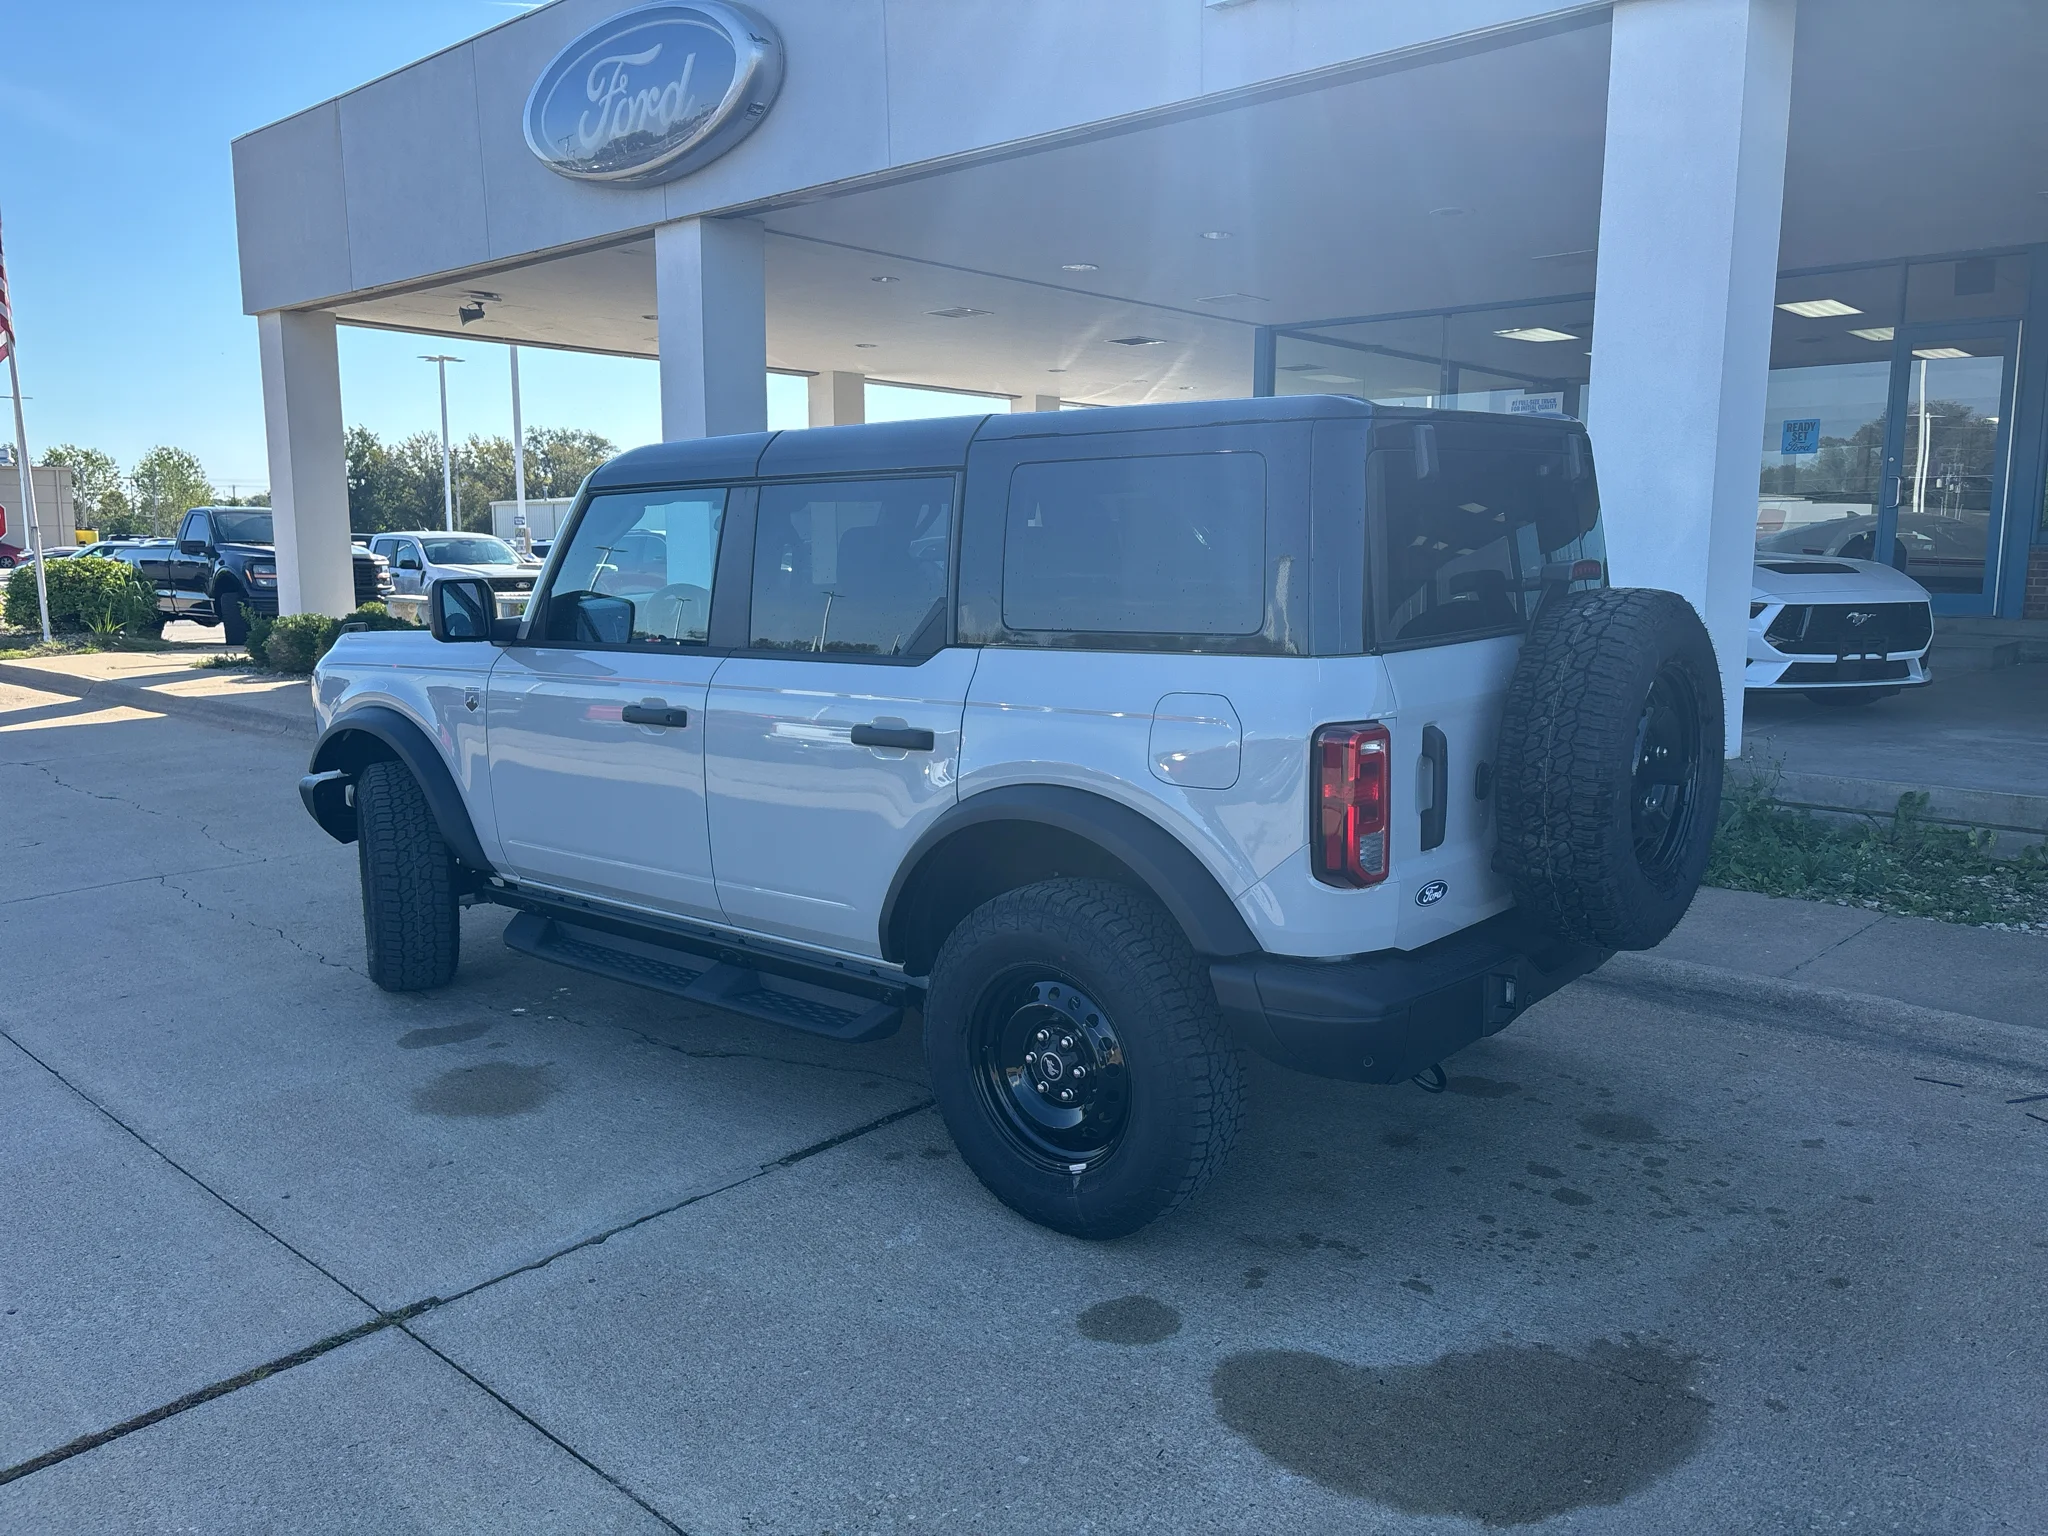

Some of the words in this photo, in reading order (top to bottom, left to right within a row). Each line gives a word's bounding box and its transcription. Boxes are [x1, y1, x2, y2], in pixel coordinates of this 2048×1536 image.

[578, 43, 697, 149] Ford
[1538, 403, 1557, 411] QUALITY
[1786, 422, 1816, 432] READY
[1792, 432, 1808, 441] SET
[1785, 441, 1812, 452] Ford
[1423, 885, 1443, 902] Ford
